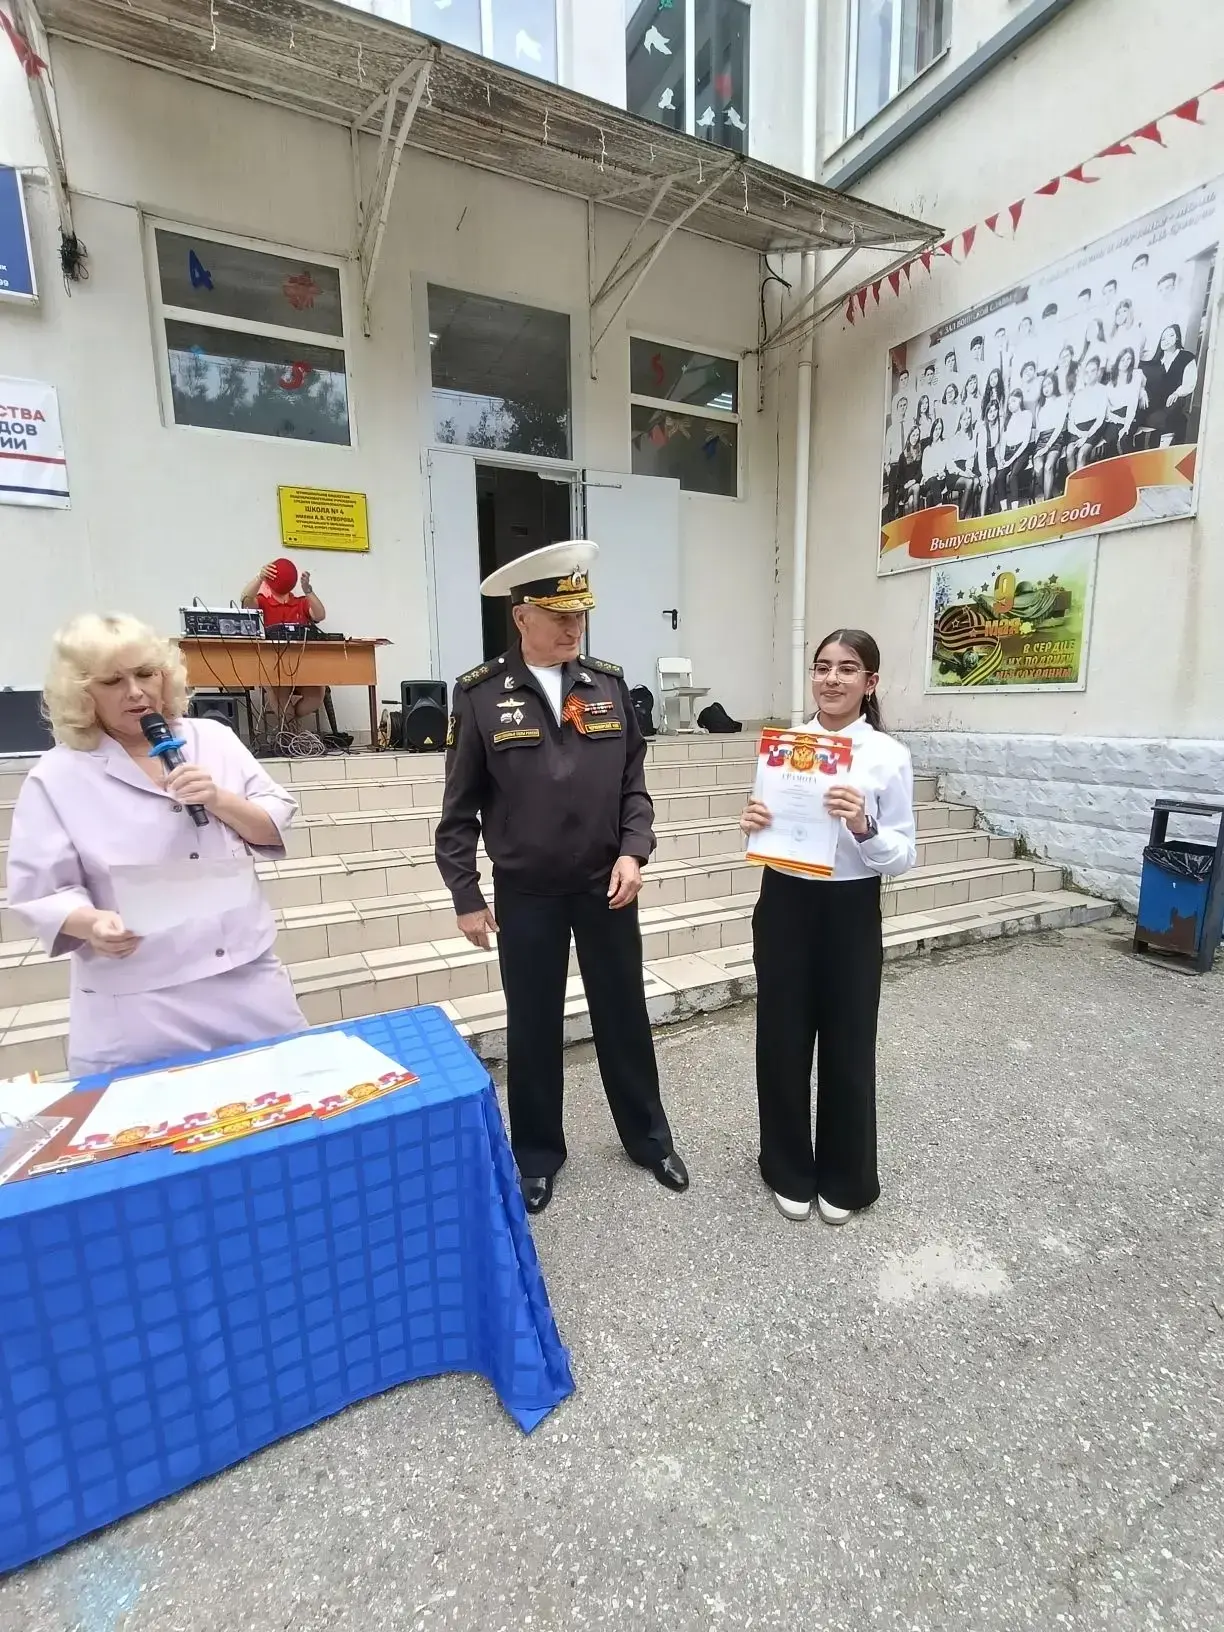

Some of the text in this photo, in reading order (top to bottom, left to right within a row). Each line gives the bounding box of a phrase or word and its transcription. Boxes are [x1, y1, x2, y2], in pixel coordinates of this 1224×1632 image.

[305, 506, 330, 514] ШКОЛА
[326, 515, 354, 523] СУВОРОВА
[929, 502, 1101, 551] Выпускники 2021 года
[992, 571, 1016, 614] 9
[1022, 639, 1076, 654] В СЕРДЦЕ
